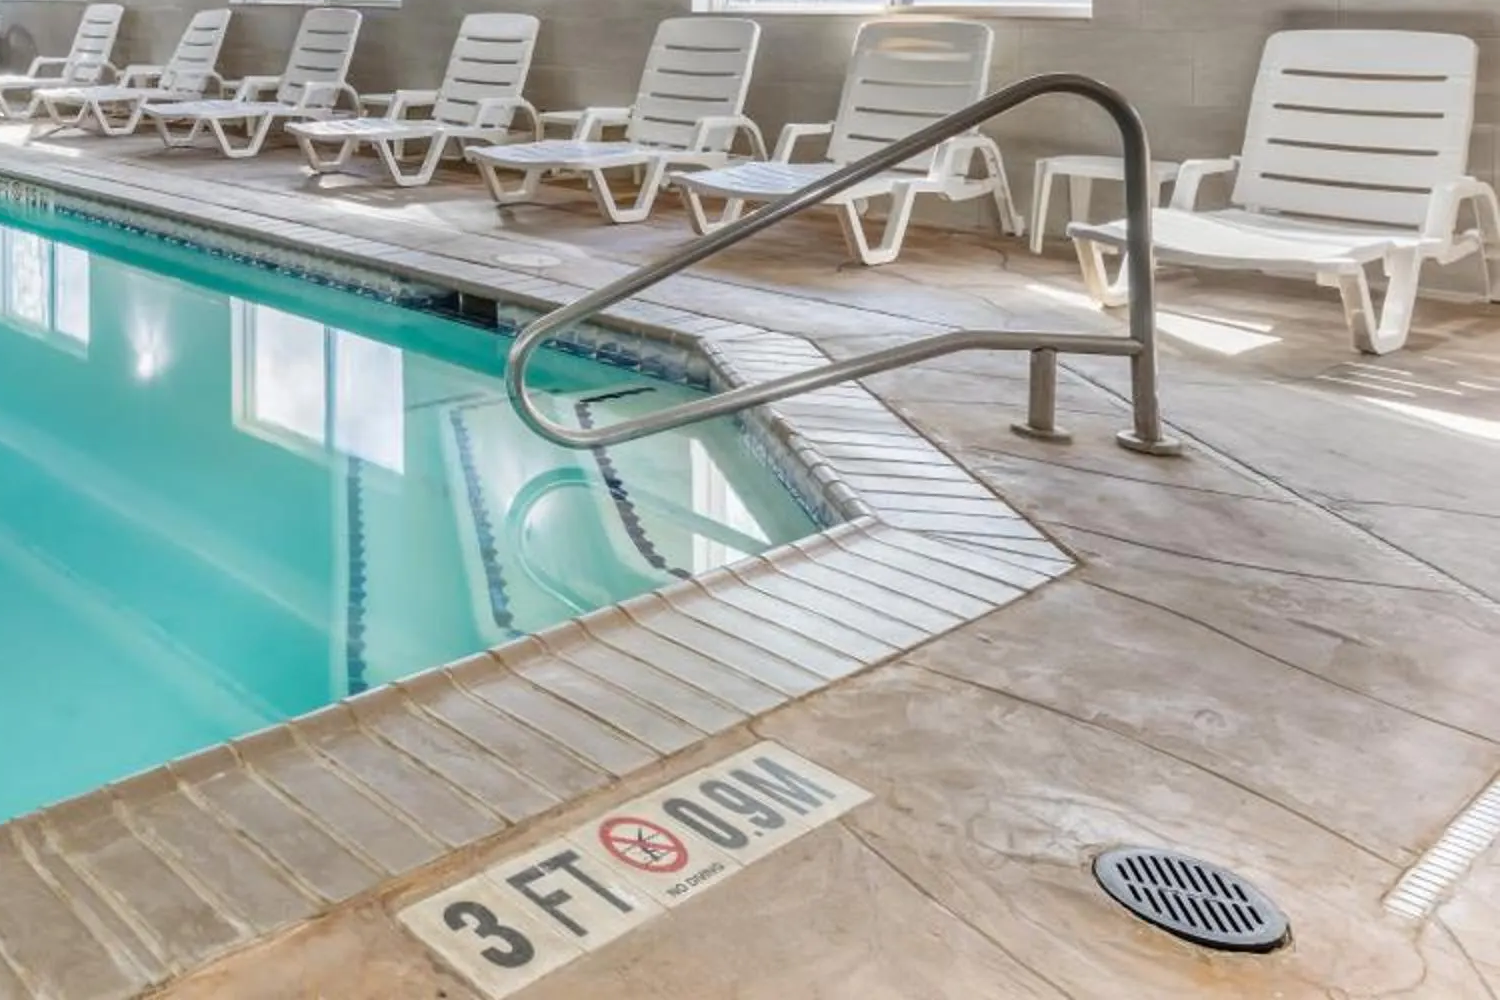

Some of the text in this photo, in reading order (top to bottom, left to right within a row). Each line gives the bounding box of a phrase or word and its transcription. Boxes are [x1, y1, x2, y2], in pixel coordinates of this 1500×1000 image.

[442, 756, 837, 969] 3 FT 0.9M
[666, 861, 725, 898] NO DIVING
